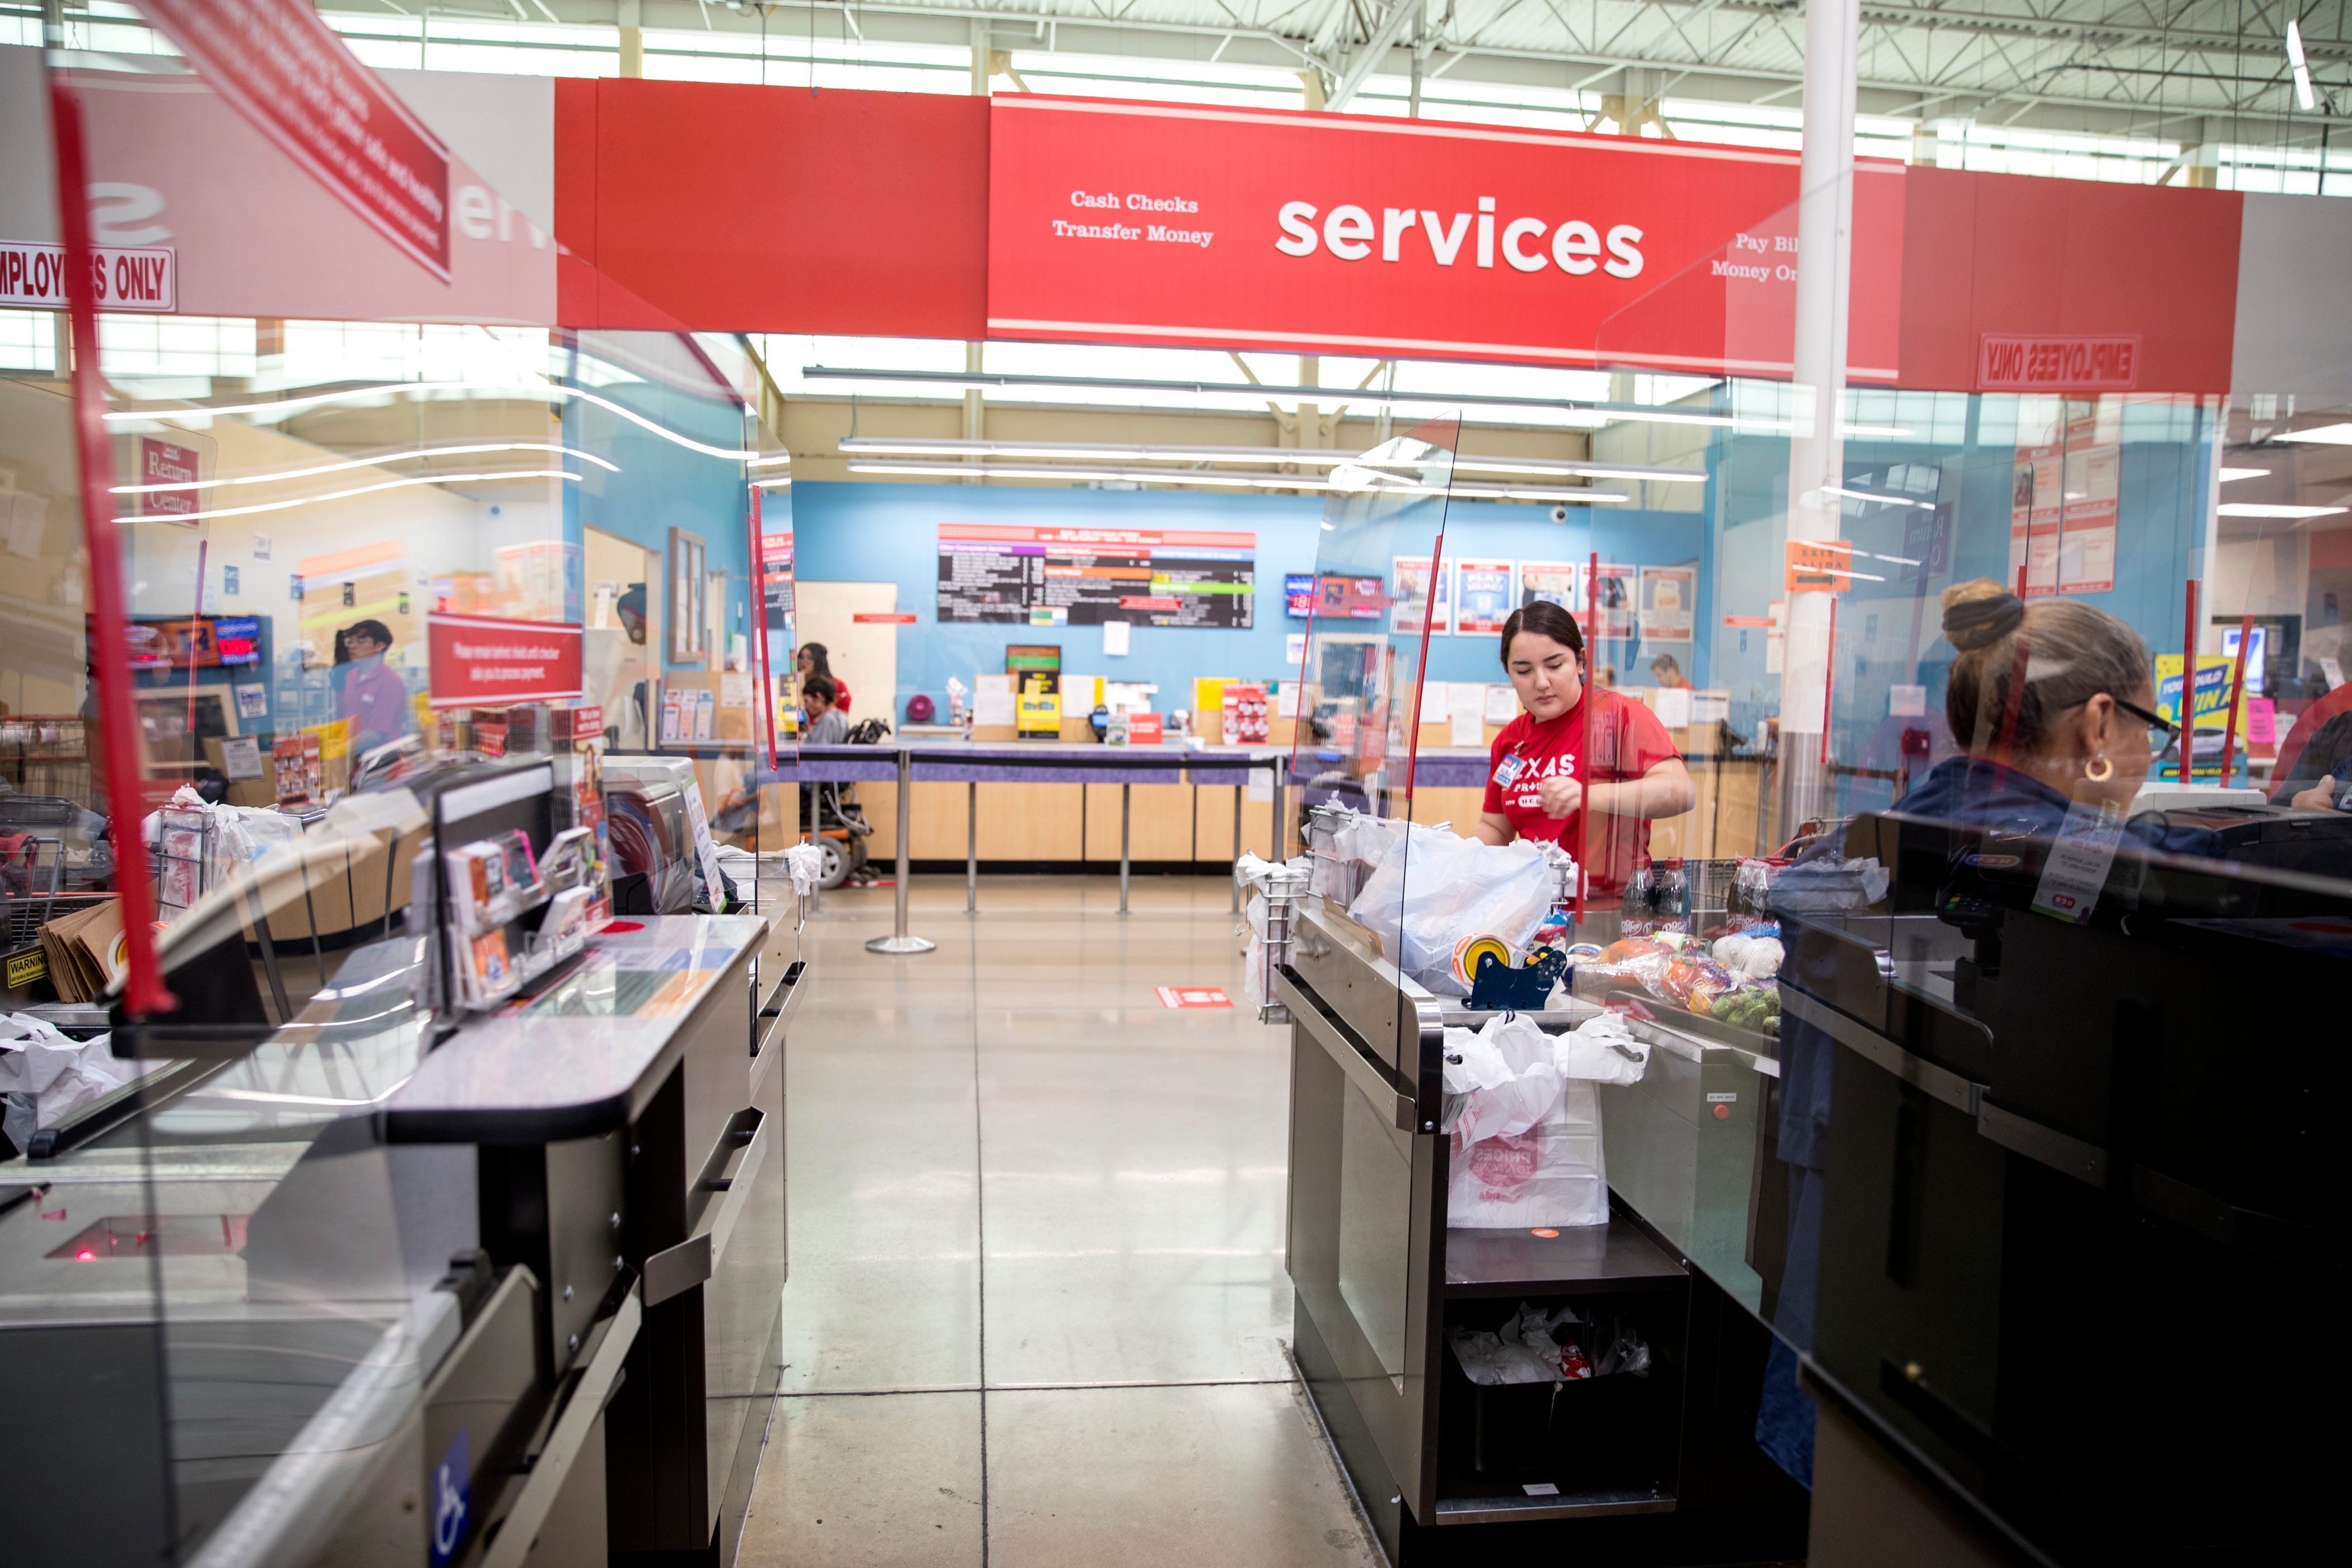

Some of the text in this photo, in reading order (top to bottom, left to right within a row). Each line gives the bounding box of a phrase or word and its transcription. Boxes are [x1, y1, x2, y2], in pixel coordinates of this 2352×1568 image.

[1071, 190, 1198, 213] Cash Checks
[1052, 220, 1214, 248] Transfer Money
[1275, 196, 1644, 278] services
[1735, 232, 1798, 253] Pay Bil
[116, 255, 166, 301] ONLY
[1711, 260, 1770, 283] Money
[2194, 670, 2223, 688] OULD
